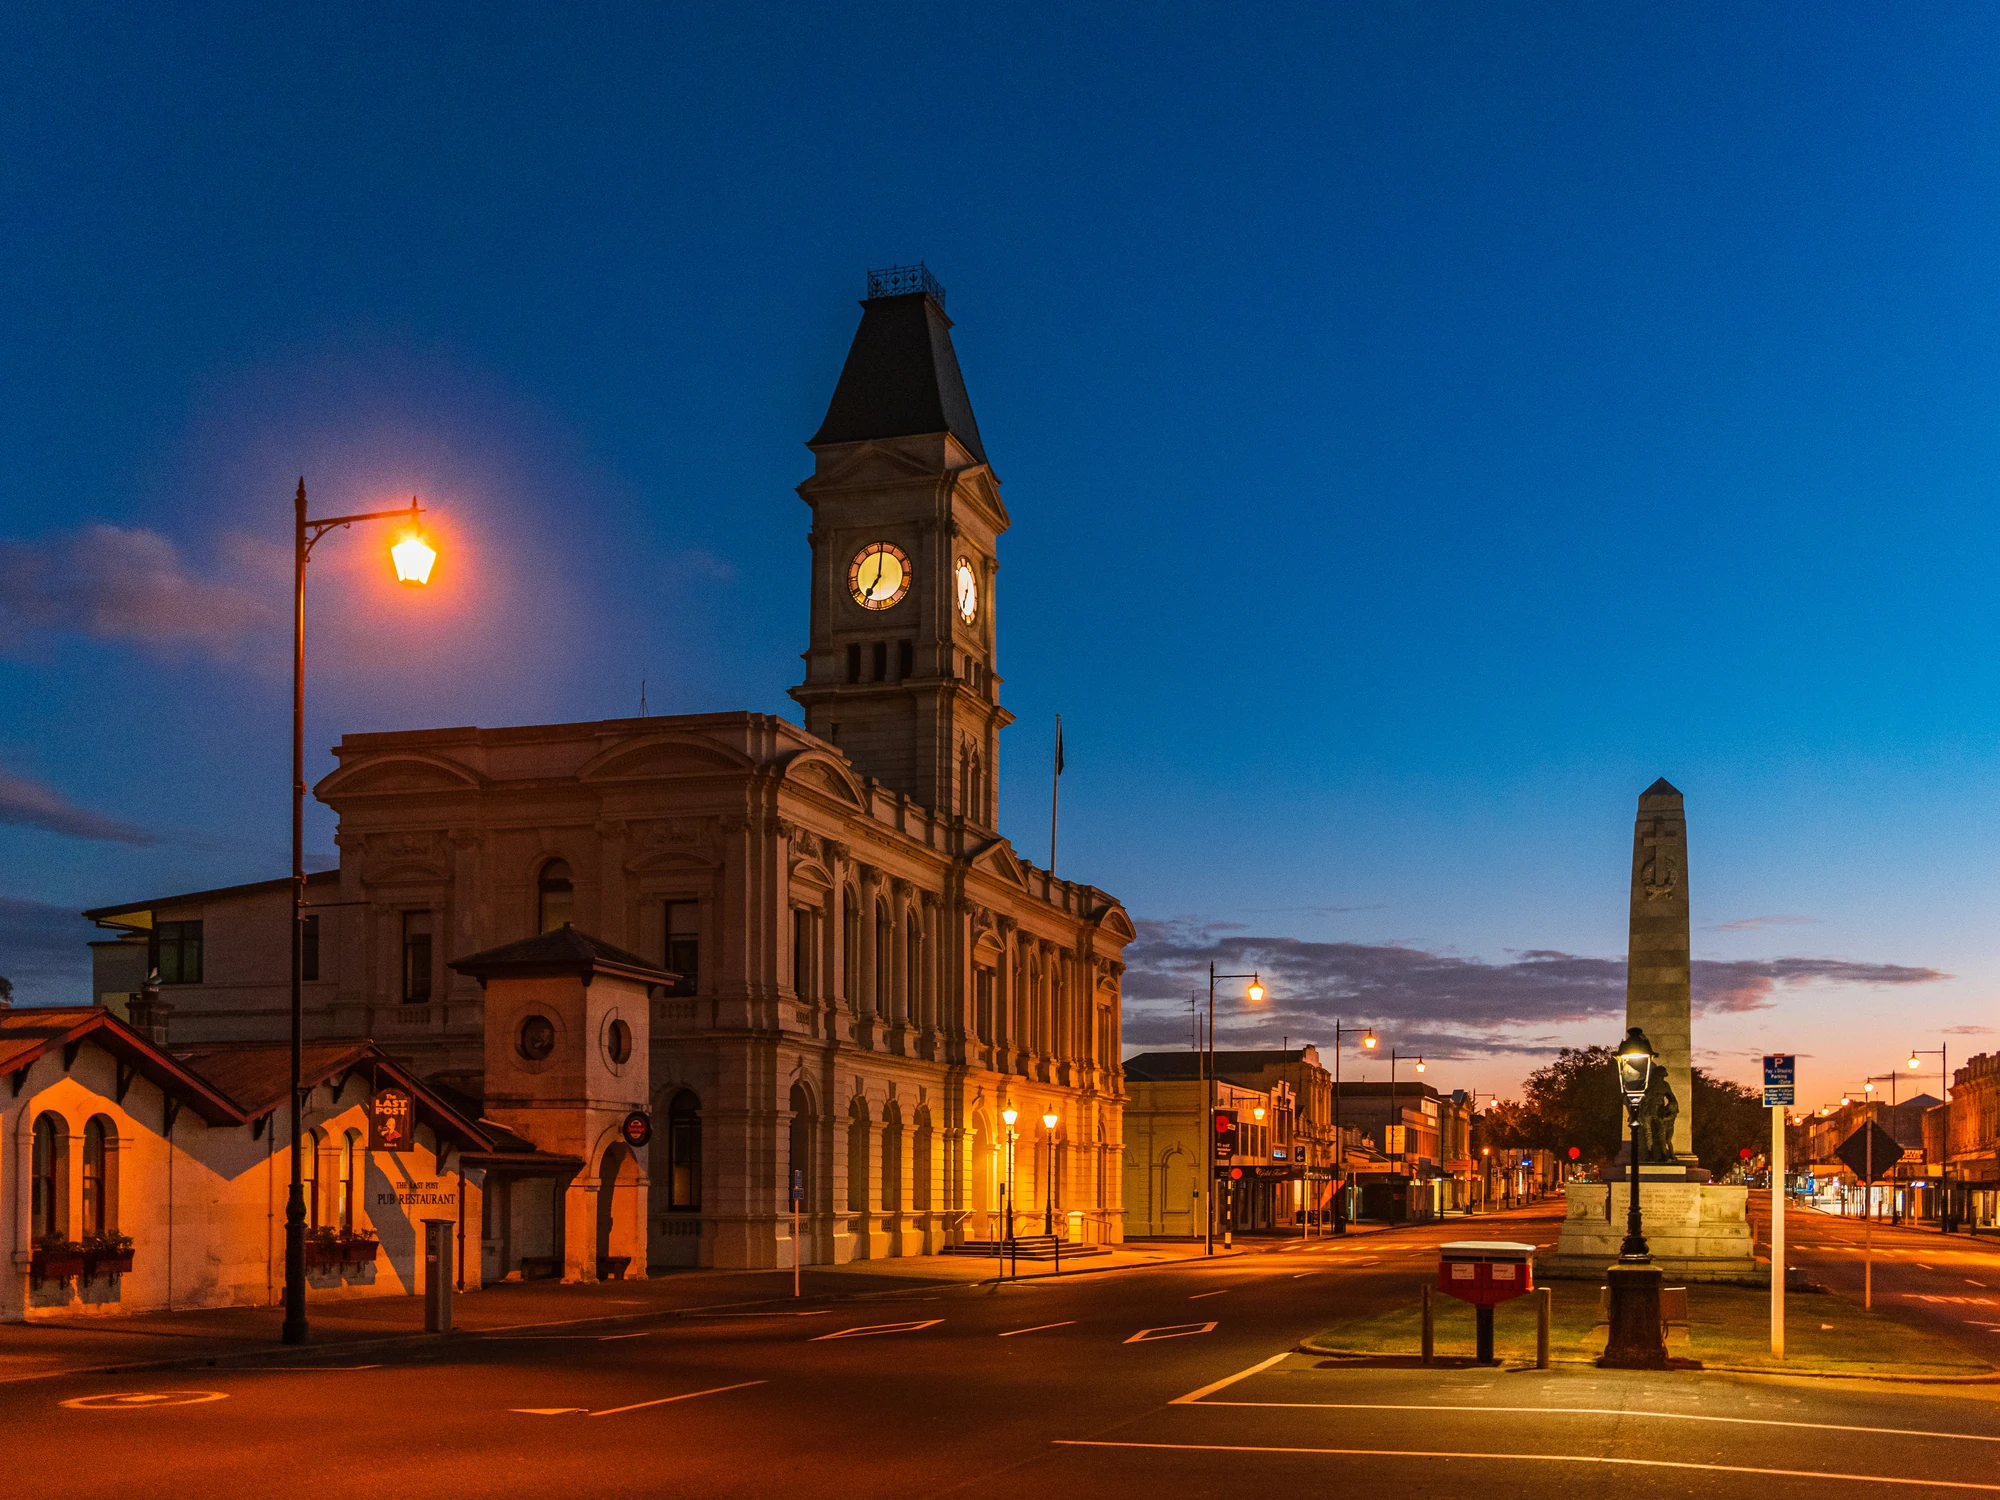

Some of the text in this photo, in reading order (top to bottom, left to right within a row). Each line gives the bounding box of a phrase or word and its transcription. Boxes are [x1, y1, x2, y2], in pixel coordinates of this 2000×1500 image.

[1774, 1057, 1784, 1068] P
[375, 1099, 408, 1107] LAST
[375, 1107, 408, 1115] POST
[409, 1182, 424, 1190] LAST
[377, 1193, 456, 1205] PUB RESTAURANT
